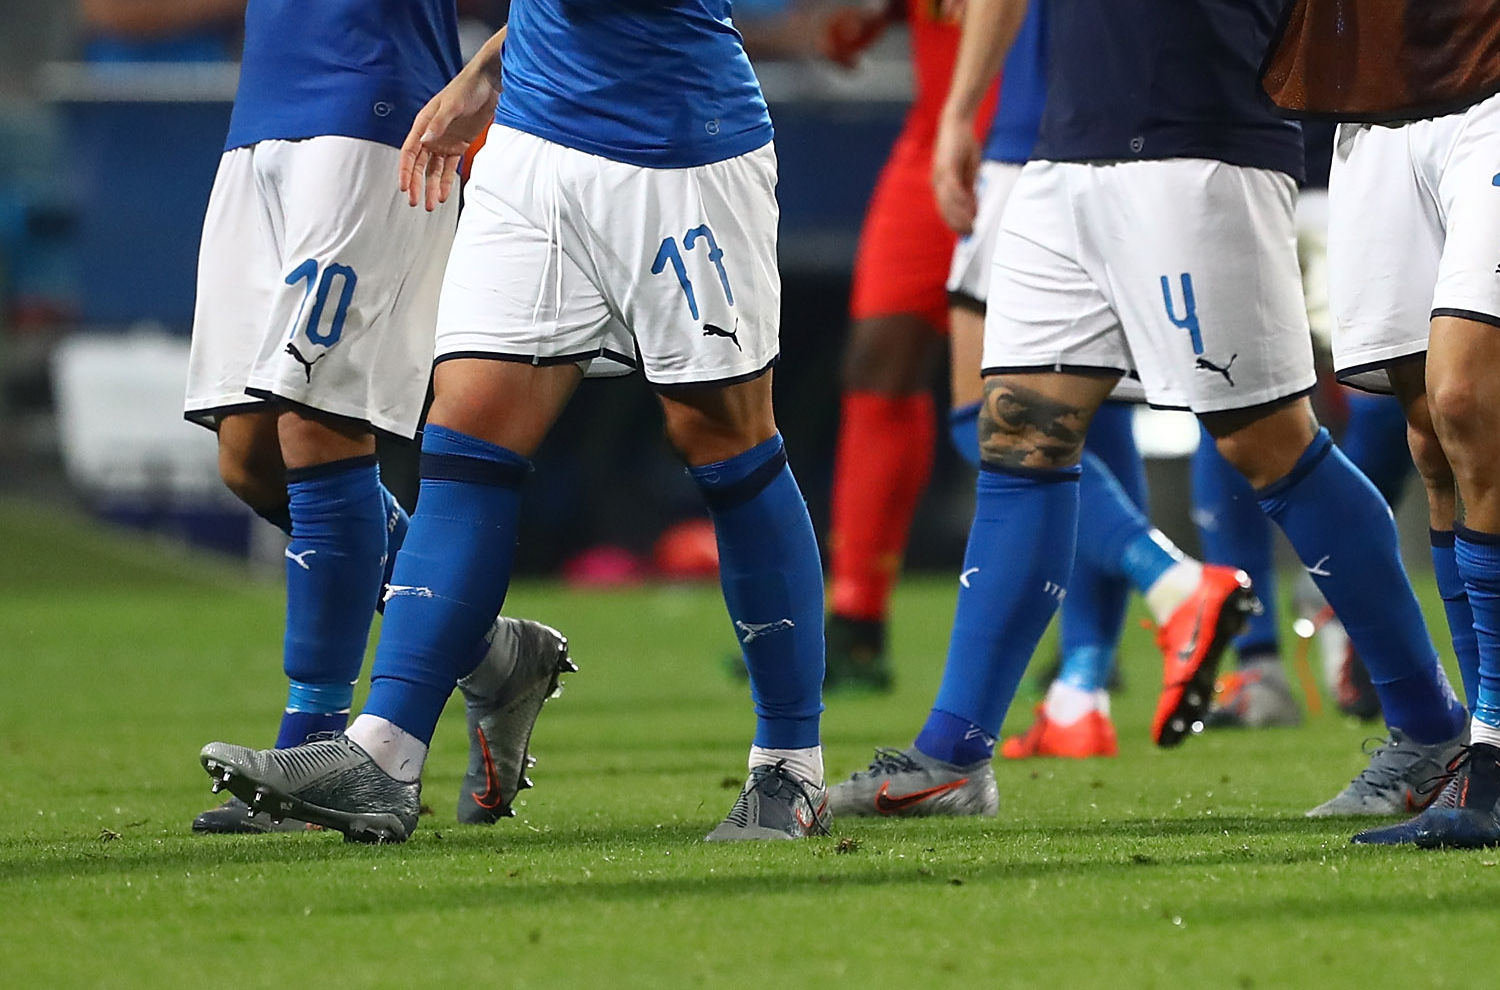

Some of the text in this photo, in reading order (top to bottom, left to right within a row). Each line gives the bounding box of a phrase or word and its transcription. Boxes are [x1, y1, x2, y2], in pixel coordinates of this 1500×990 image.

[285, 258, 358, 348] 10
[651, 224, 735, 321] 17
[1160, 272, 1204, 355] 4
